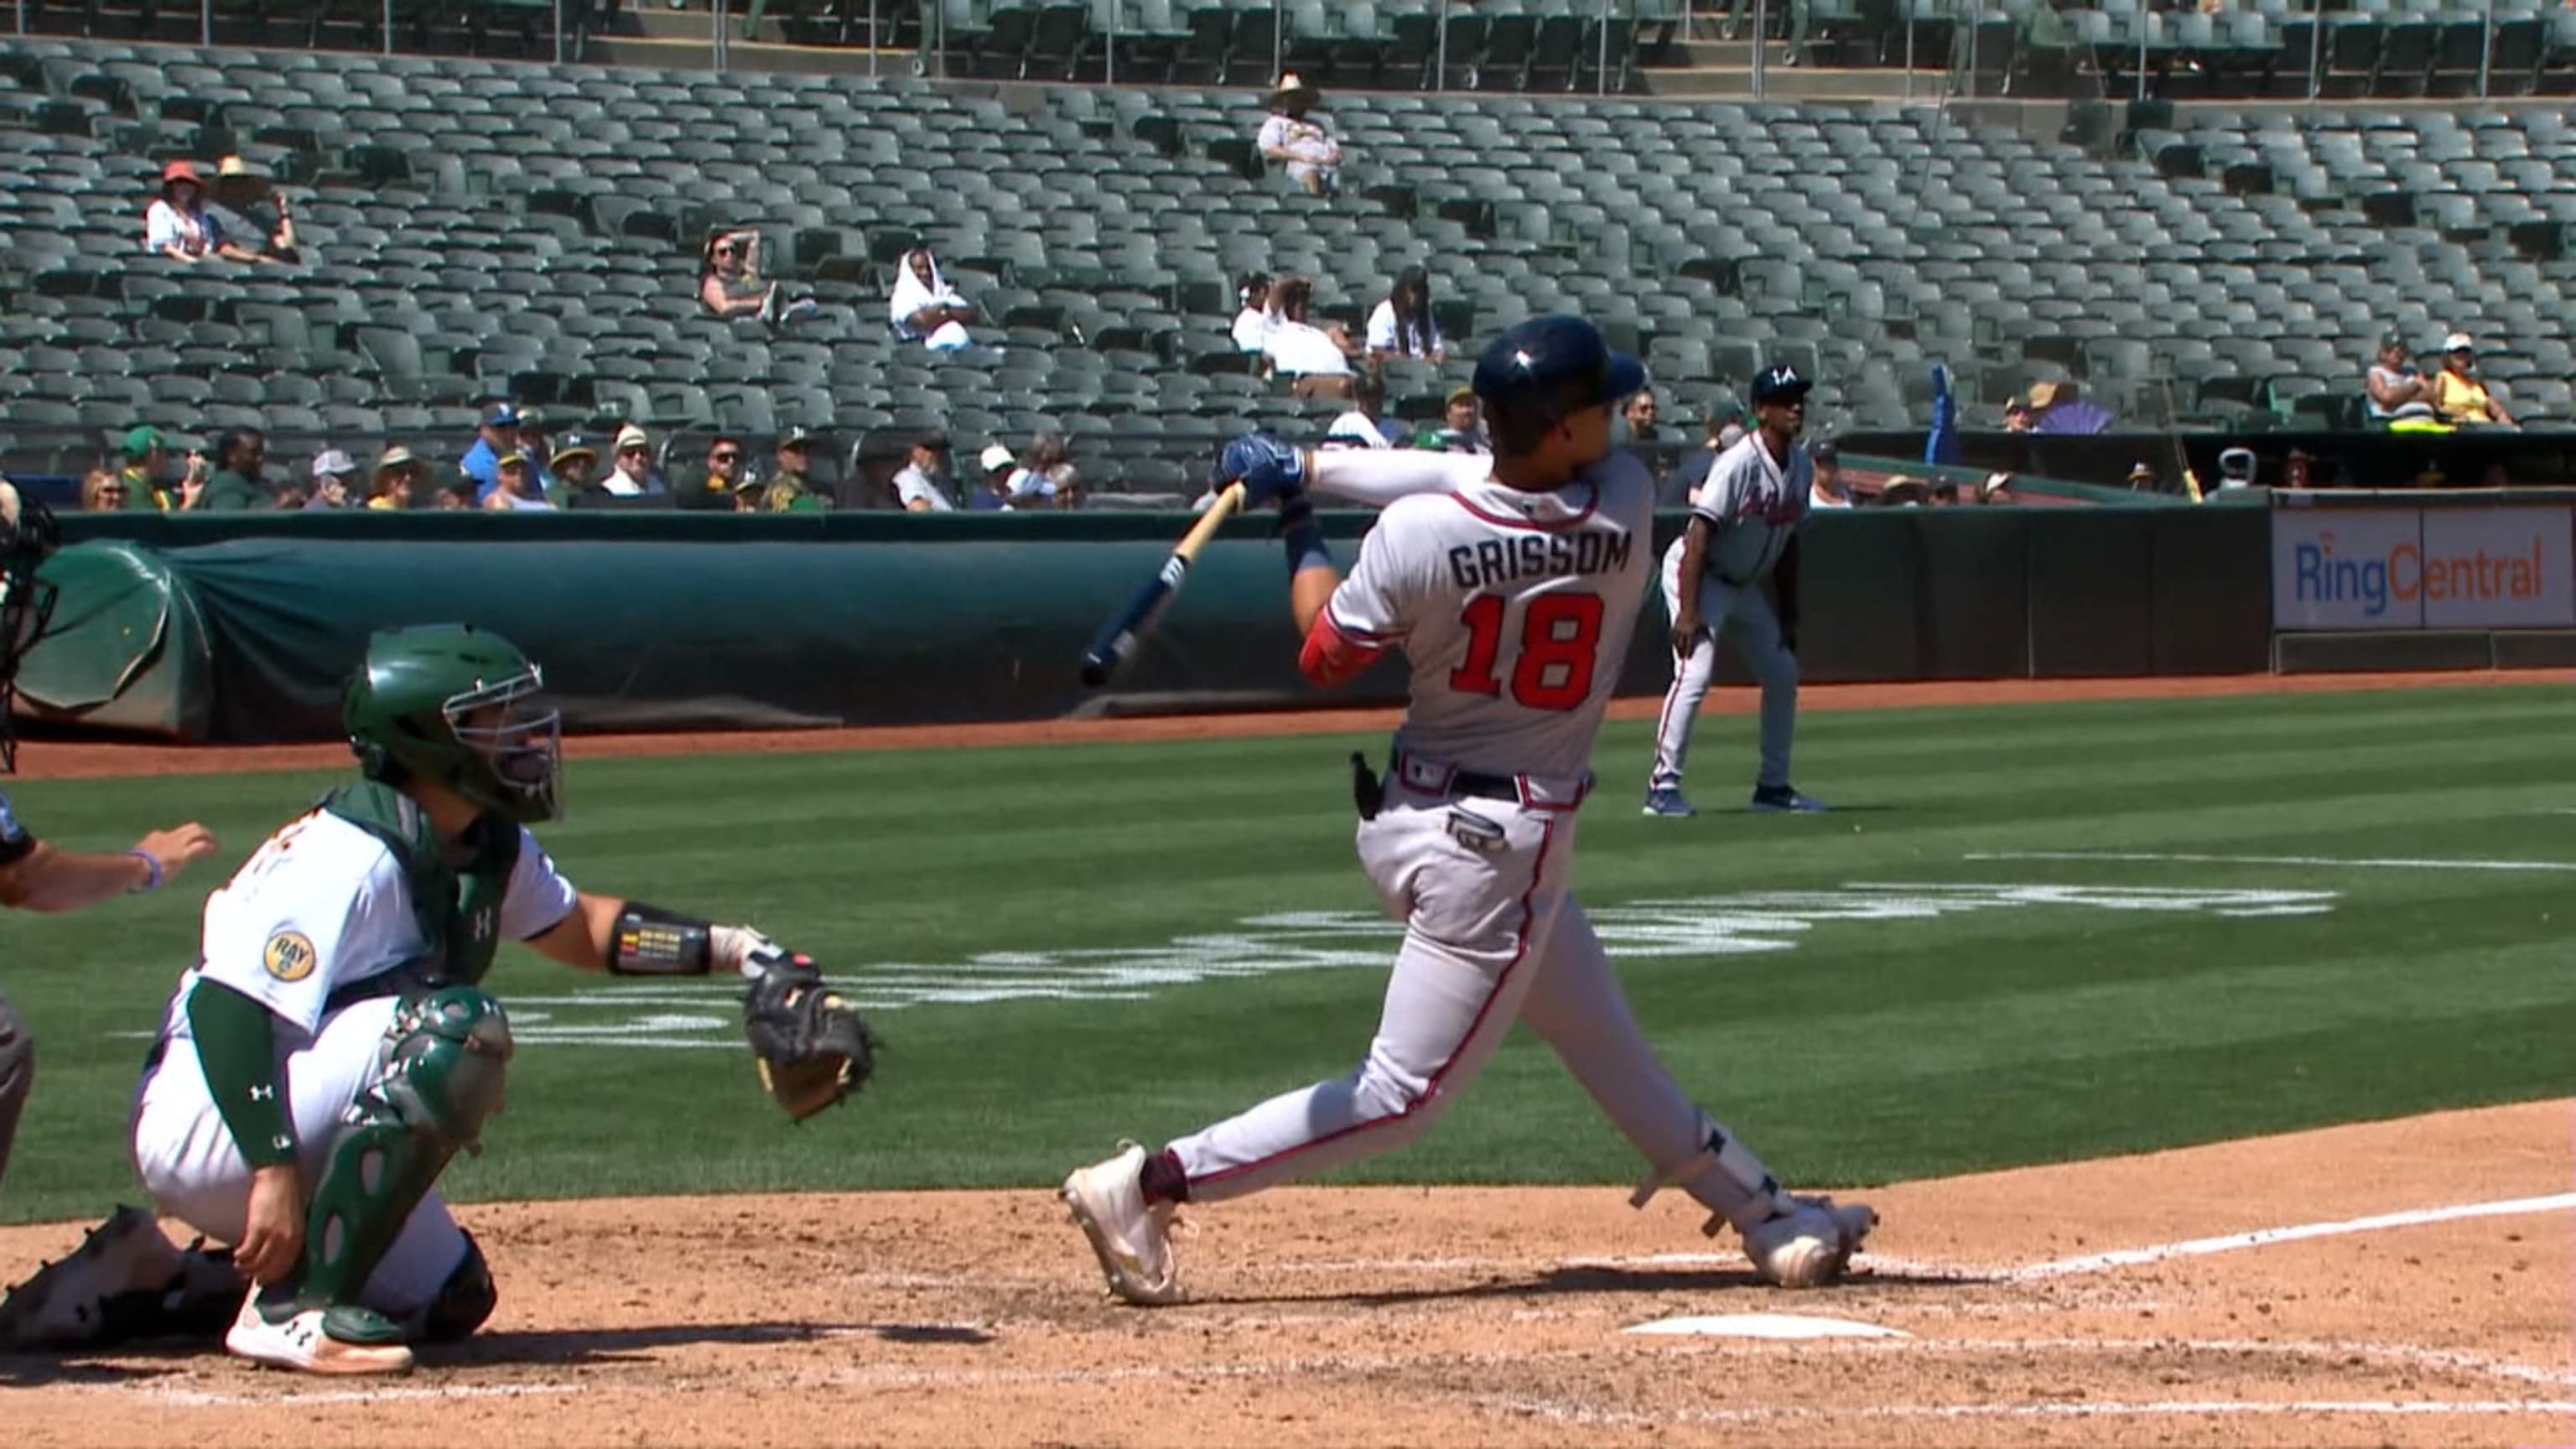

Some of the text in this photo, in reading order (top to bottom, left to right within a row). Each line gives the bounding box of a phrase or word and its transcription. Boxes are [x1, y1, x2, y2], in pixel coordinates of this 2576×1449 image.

[1447, 531, 1631, 589] GRISSOM
[2295, 532, 2542, 616] RingCentral
[1450, 591, 1604, 710] 18
[274, 937, 309, 963] RAY
